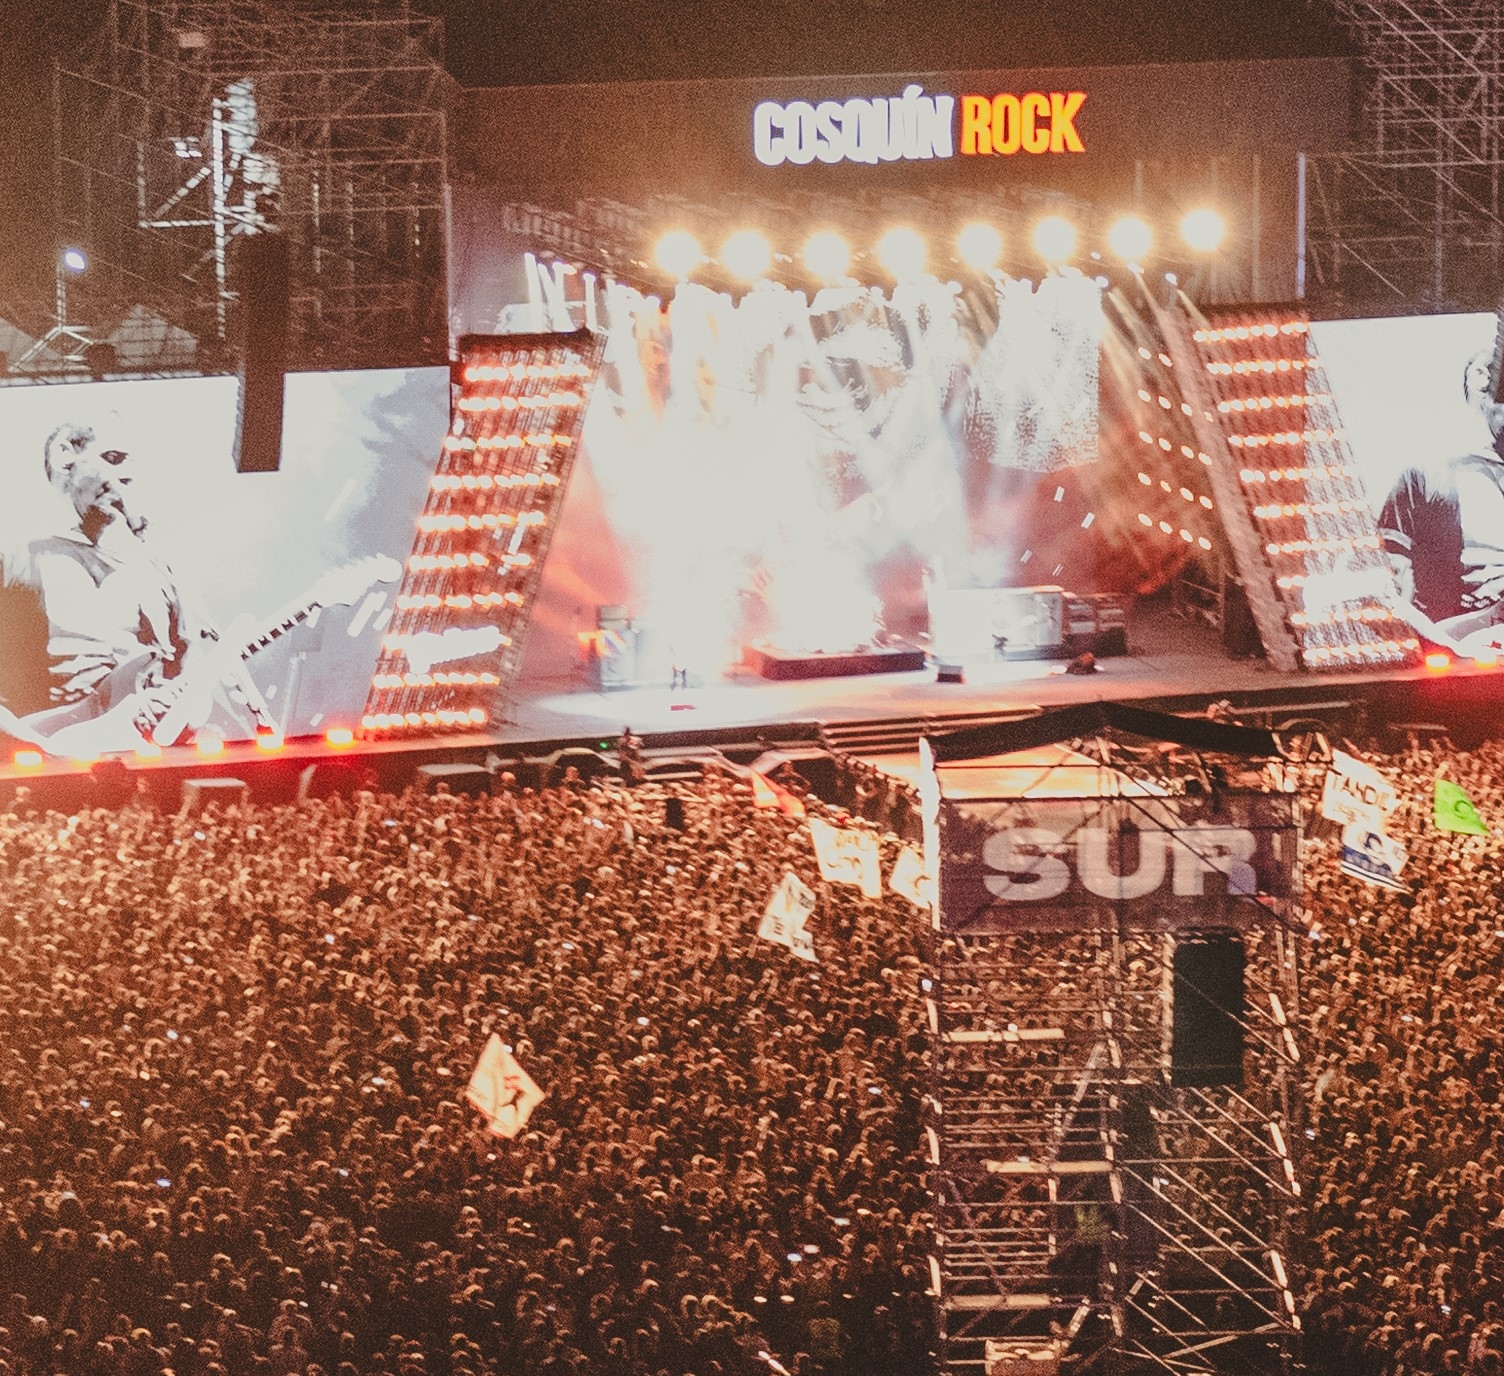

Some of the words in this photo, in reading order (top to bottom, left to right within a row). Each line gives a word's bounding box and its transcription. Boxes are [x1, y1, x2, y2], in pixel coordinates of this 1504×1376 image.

[753, 83, 955, 166] COSQUÍN
[959, 91, 1088, 156] ROCK
[981, 825, 1258, 902] SUR
